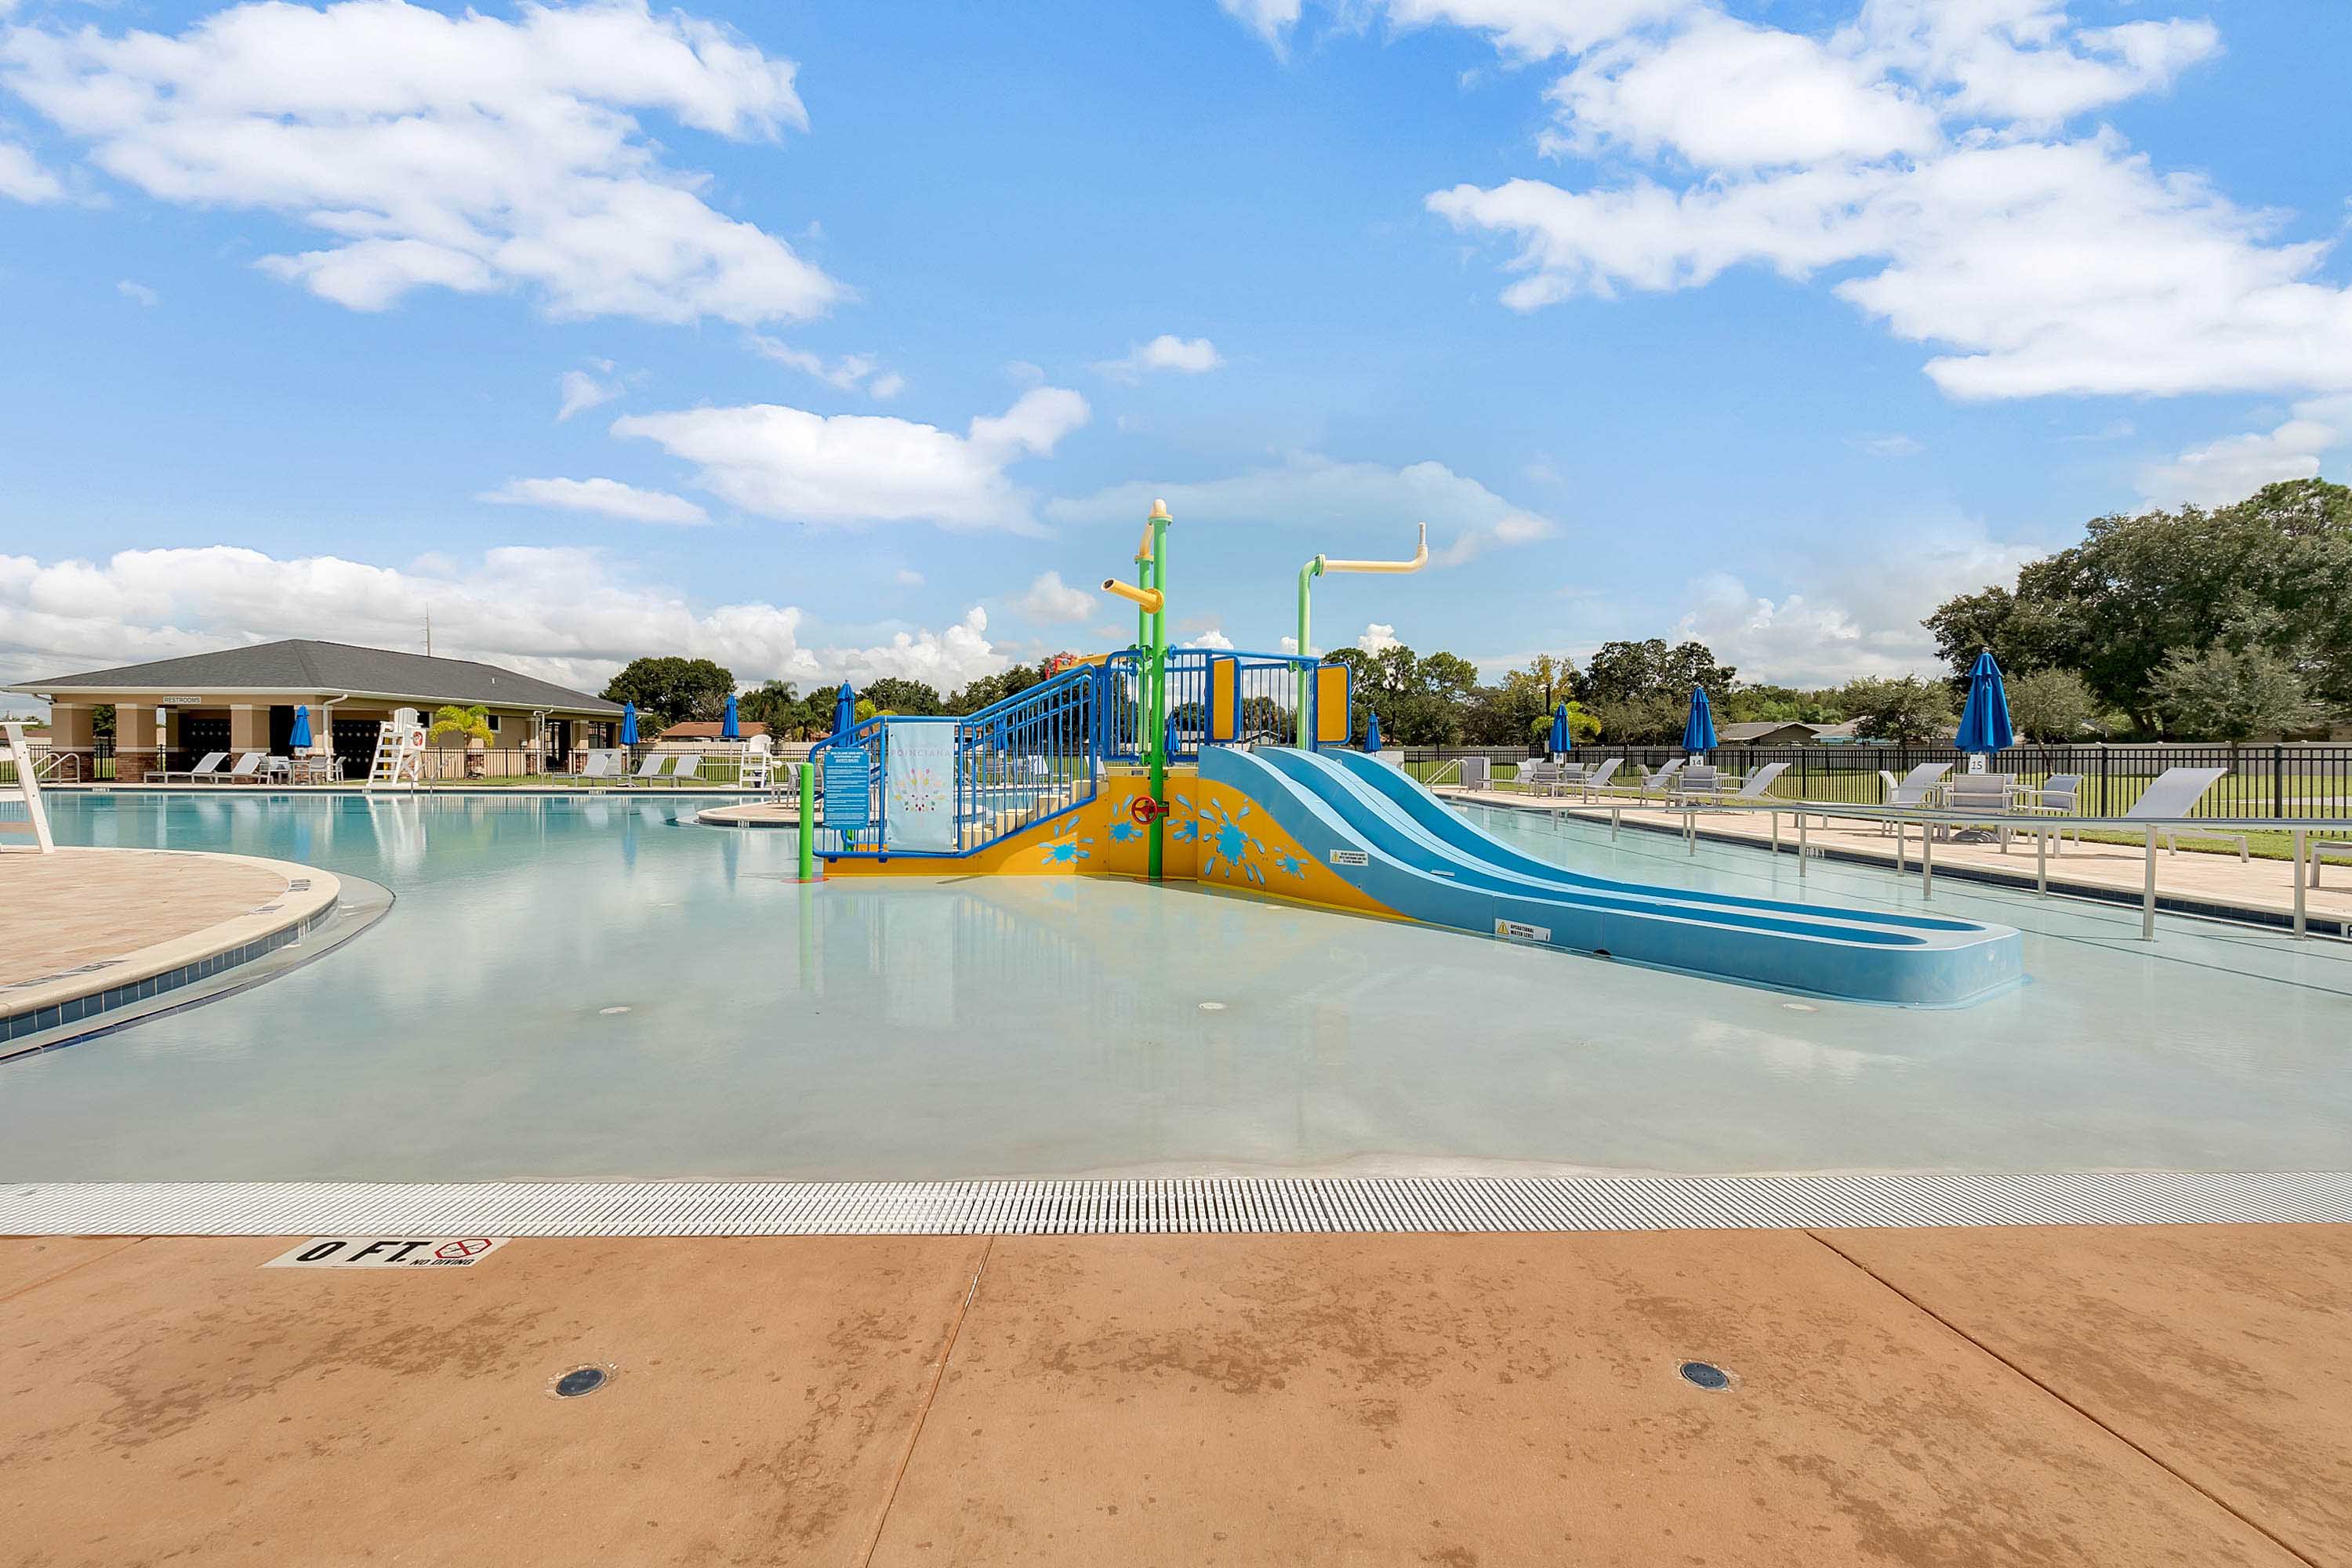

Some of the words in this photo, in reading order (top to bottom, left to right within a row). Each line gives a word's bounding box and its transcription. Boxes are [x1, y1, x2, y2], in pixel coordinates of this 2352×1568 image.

[891, 749, 950, 757] POINCIANA
[1971, 760, 1983, 770] 15
[347, 1241, 433, 1262] FT.
